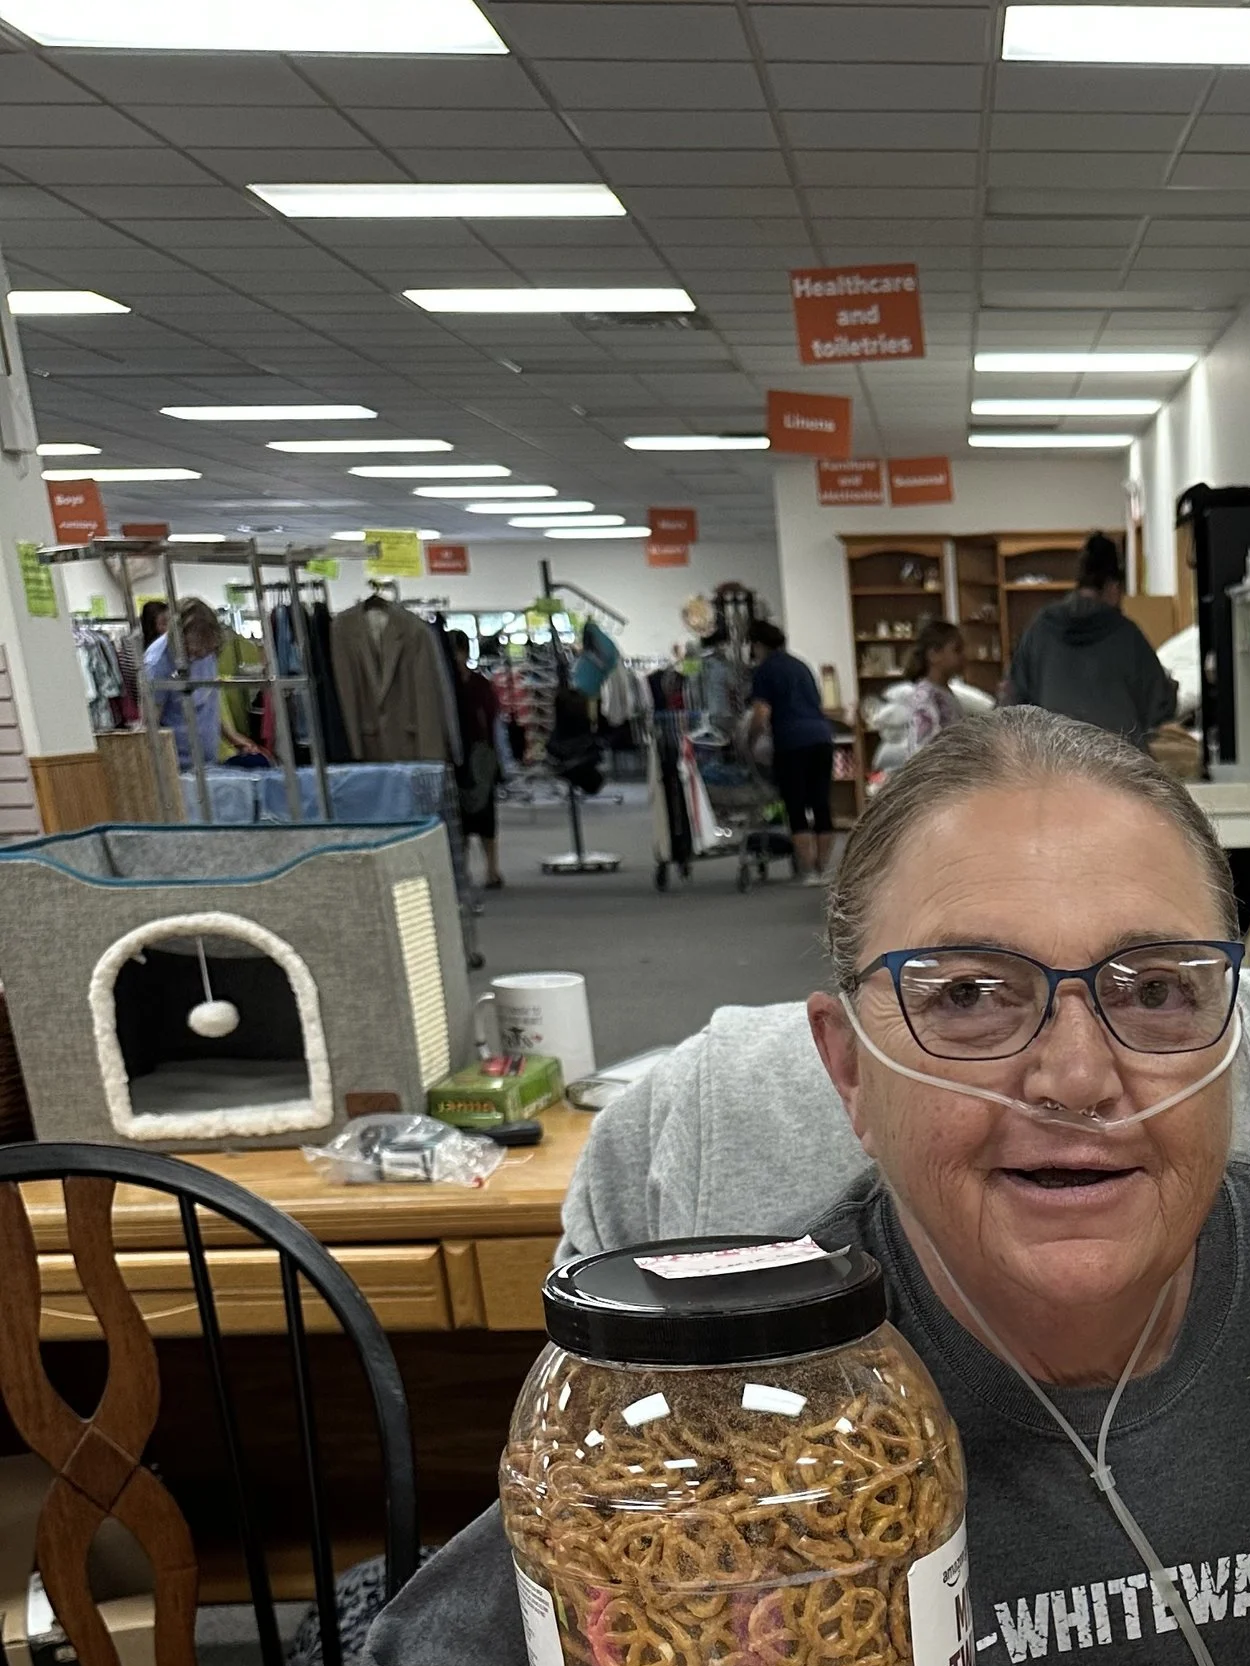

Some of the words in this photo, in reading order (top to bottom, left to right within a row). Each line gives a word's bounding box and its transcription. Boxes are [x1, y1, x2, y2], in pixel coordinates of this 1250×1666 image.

[793, 273, 916, 299] Healthcare
[836, 304, 881, 327] and
[811, 334, 913, 359] toiletries
